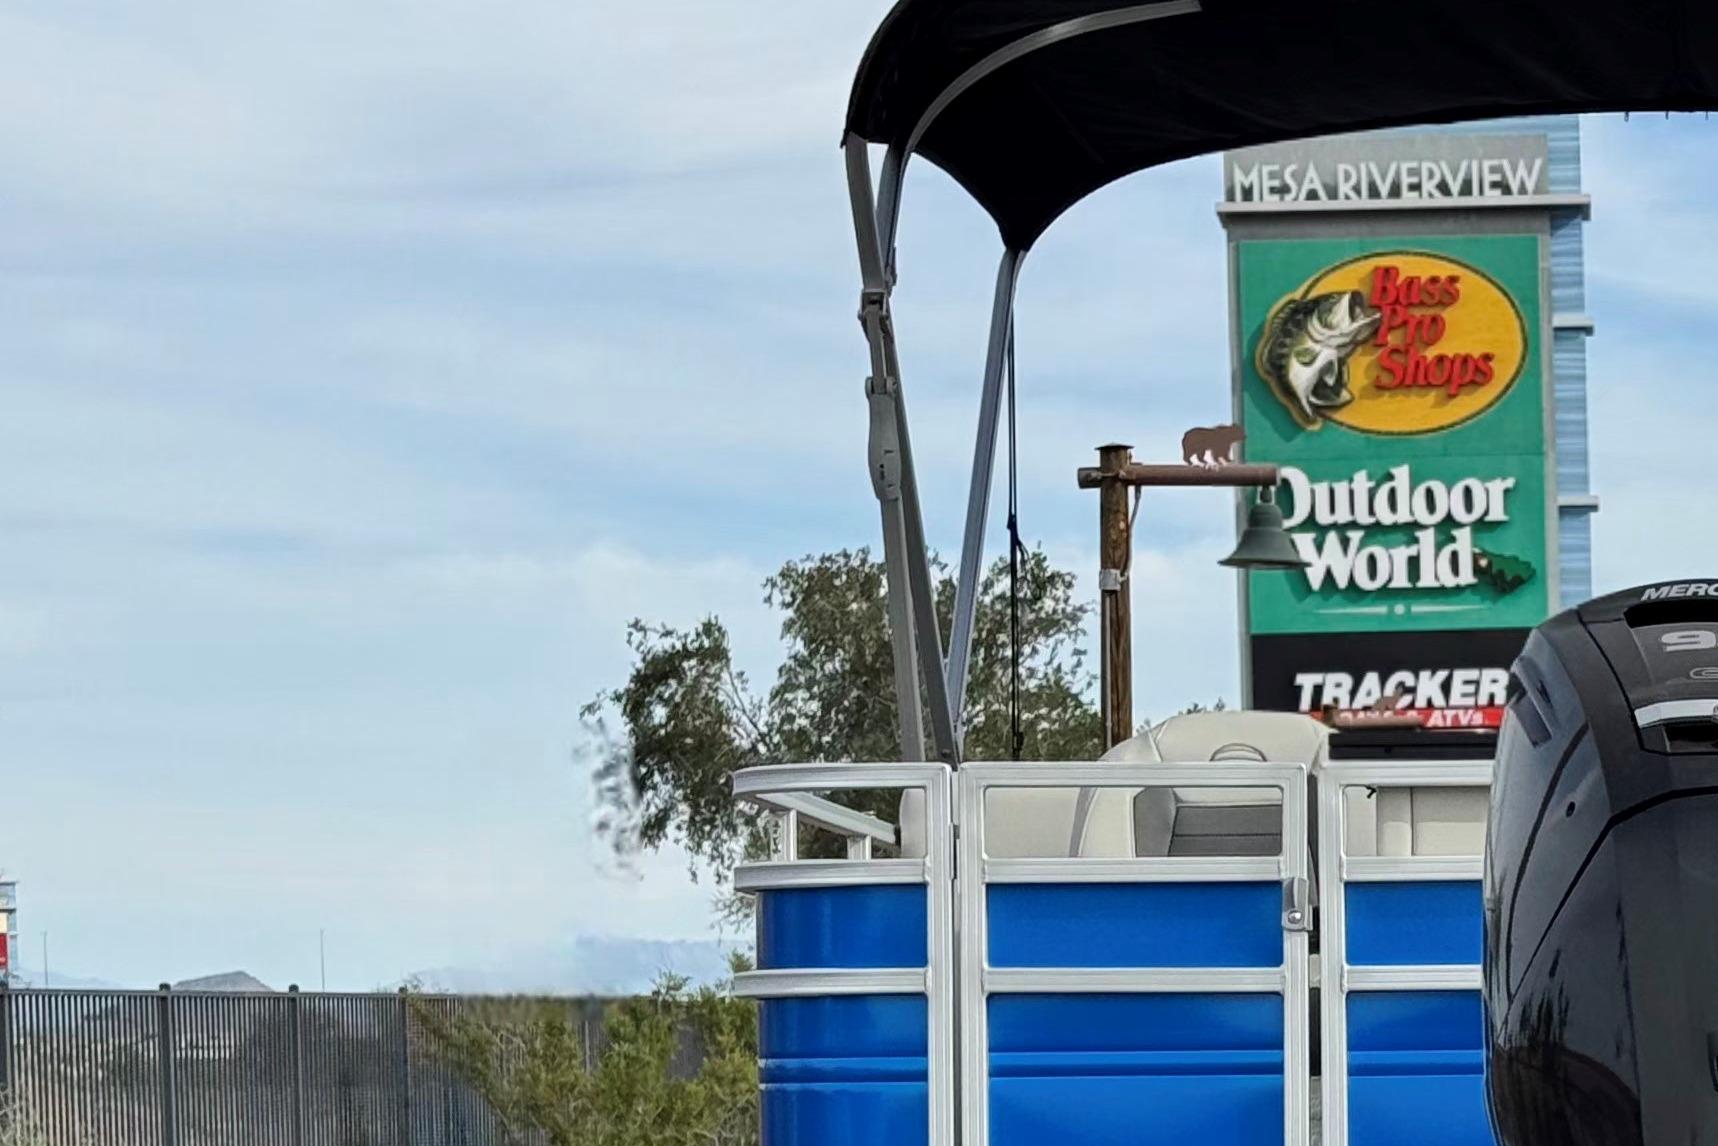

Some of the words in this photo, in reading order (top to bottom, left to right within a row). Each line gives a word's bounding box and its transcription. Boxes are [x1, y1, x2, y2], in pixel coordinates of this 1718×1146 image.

[1233, 161, 1328, 201] MESA
[1337, 158, 1542, 200] RIVERVIEW
[1369, 265, 1460, 307] Bass
[1374, 304, 1446, 347] Pro
[1375, 347, 1495, 398] Shops
[1291, 526, 1478, 591] World
[1294, 667, 1511, 713] TRACKER
[1424, 709, 1484, 728] ATVs
